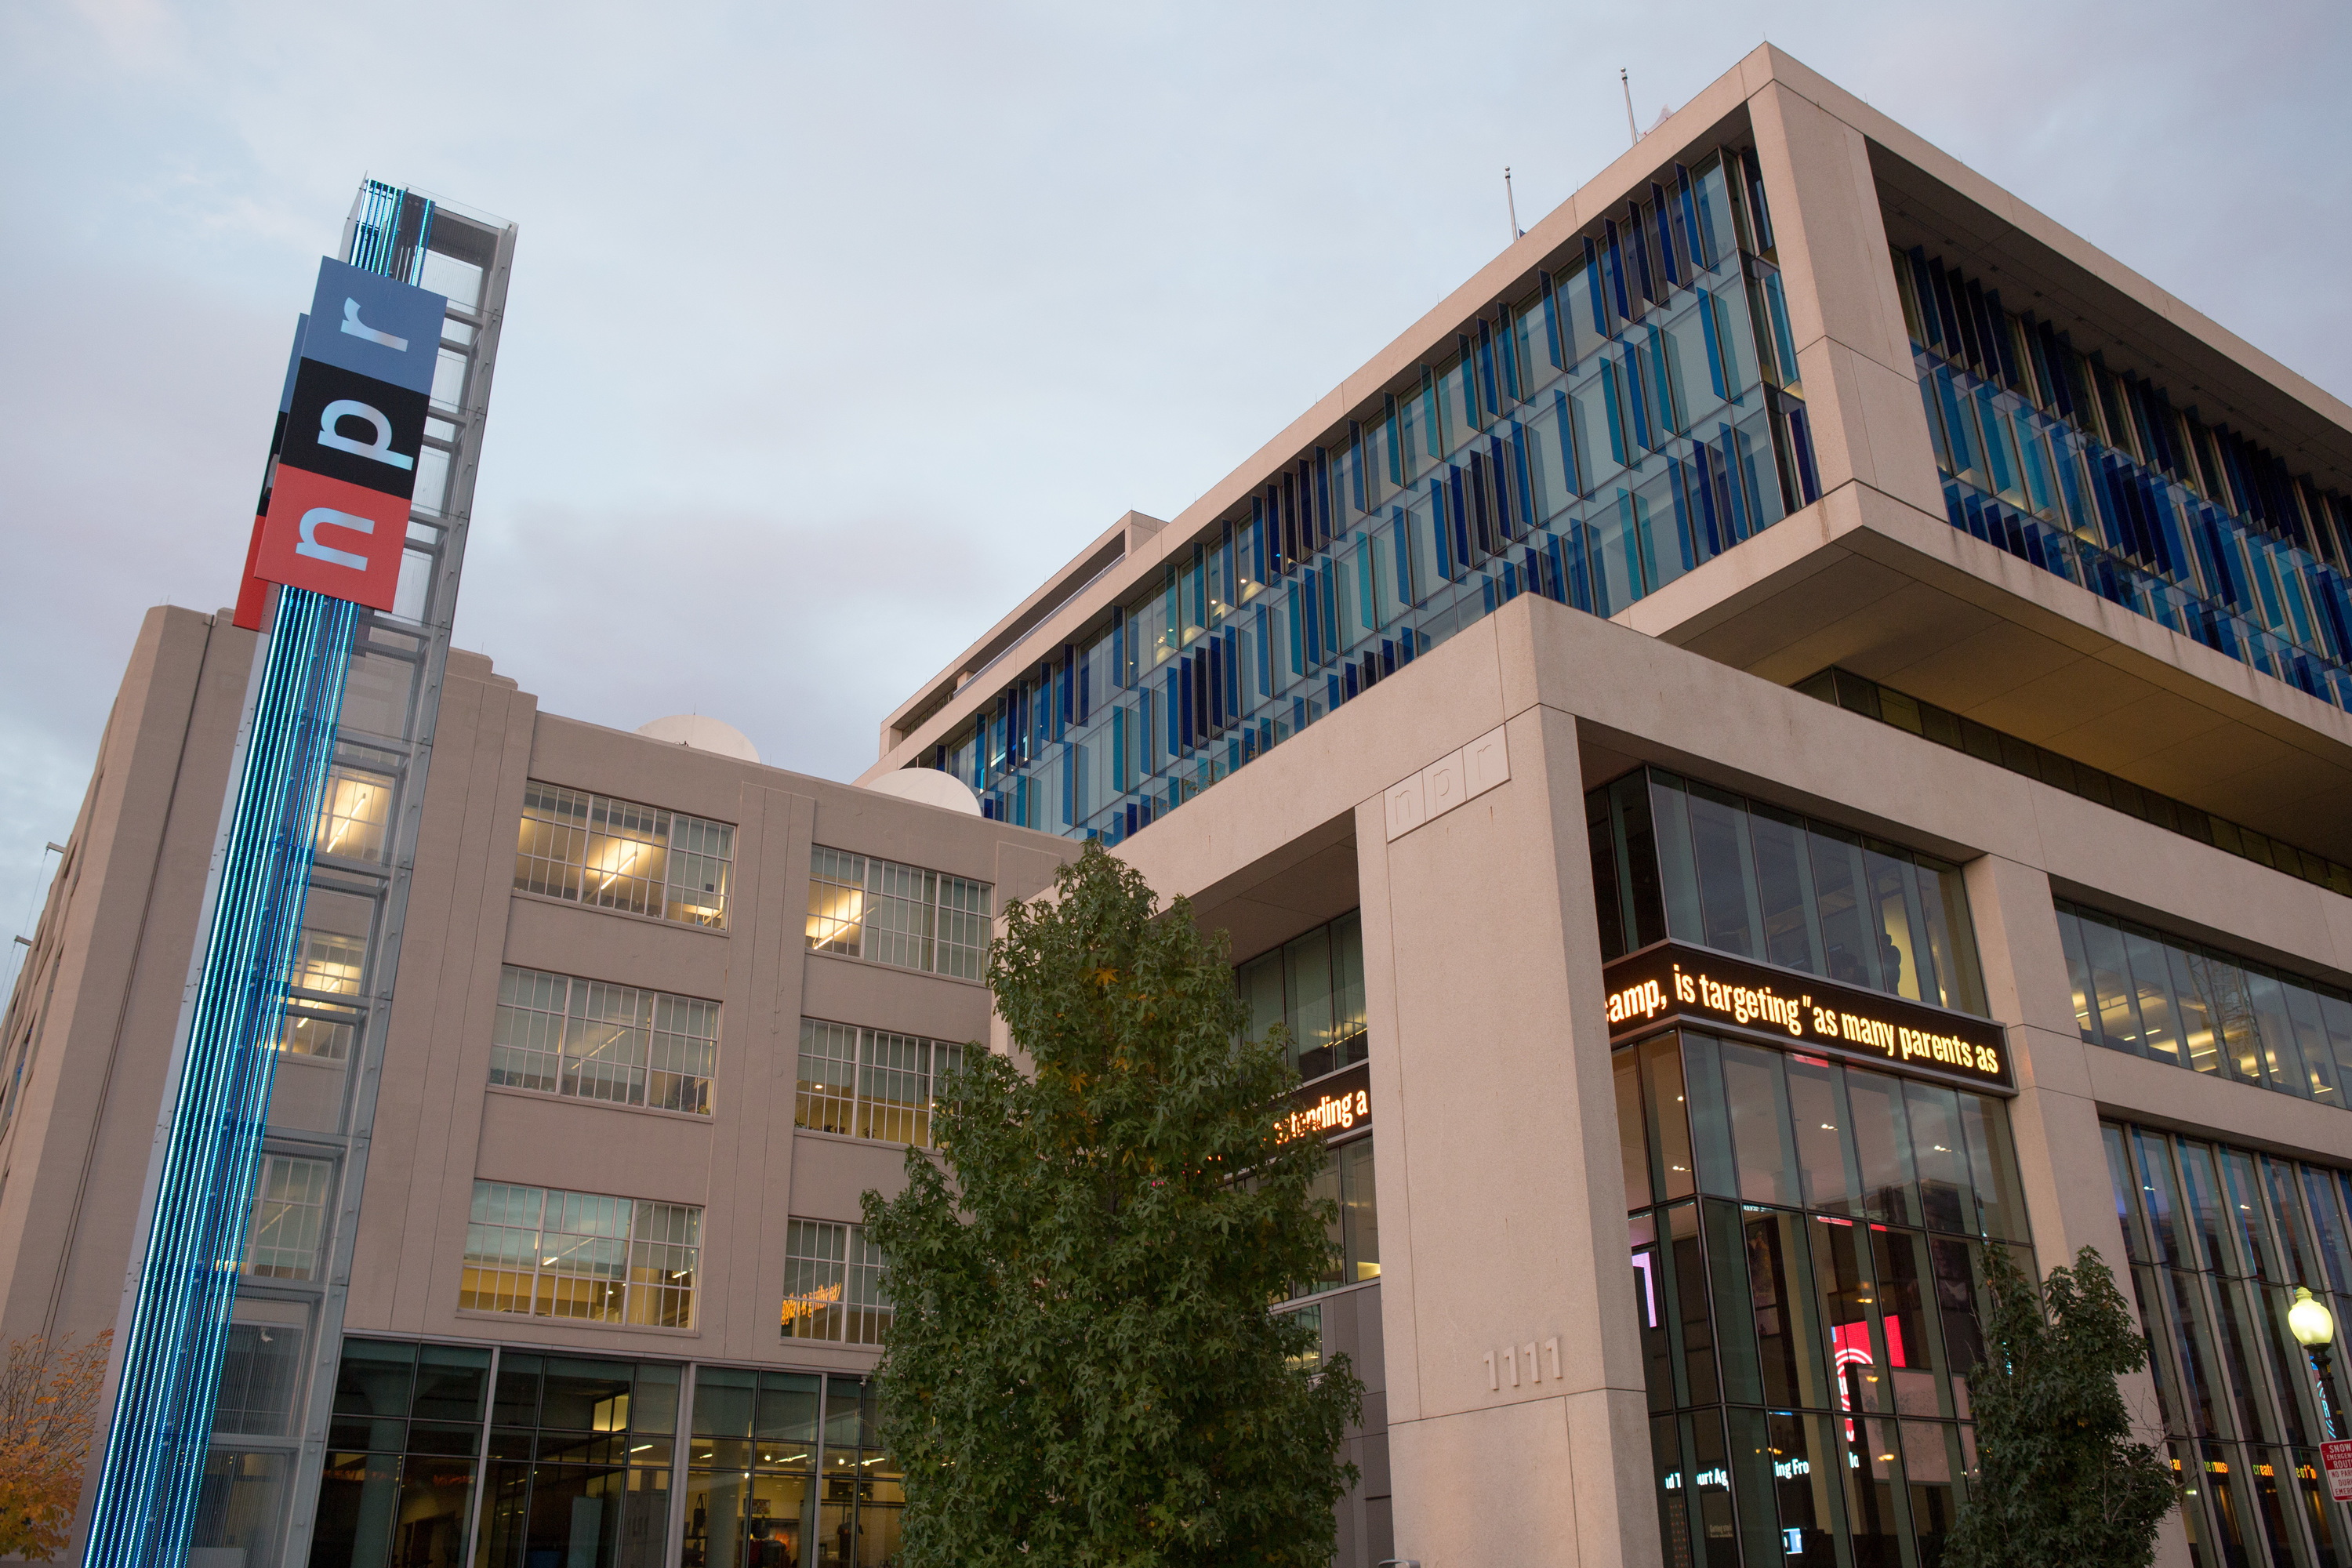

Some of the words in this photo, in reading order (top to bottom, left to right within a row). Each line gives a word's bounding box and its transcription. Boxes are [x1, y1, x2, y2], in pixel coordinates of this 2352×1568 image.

[295, 296, 414, 572] npr
[1394, 743, 1493, 826] npr
[1673, 964, 1696, 1004] is
[1698, 974, 1802, 1036] targeting
[1841, 1013, 1895, 1057] many
[1898, 1027, 1974, 1068] parents
[1975, 1045, 1999, 1074] as
[1356, 1090, 1369, 1116] a
[1483, 1336, 1563, 1392] 1111
[2326, 1452, 2352, 1461] EMERGEN
[2328, 1443, 2351, 1454] SNOW
[2332, 1460, 2352, 1469] ROUT
